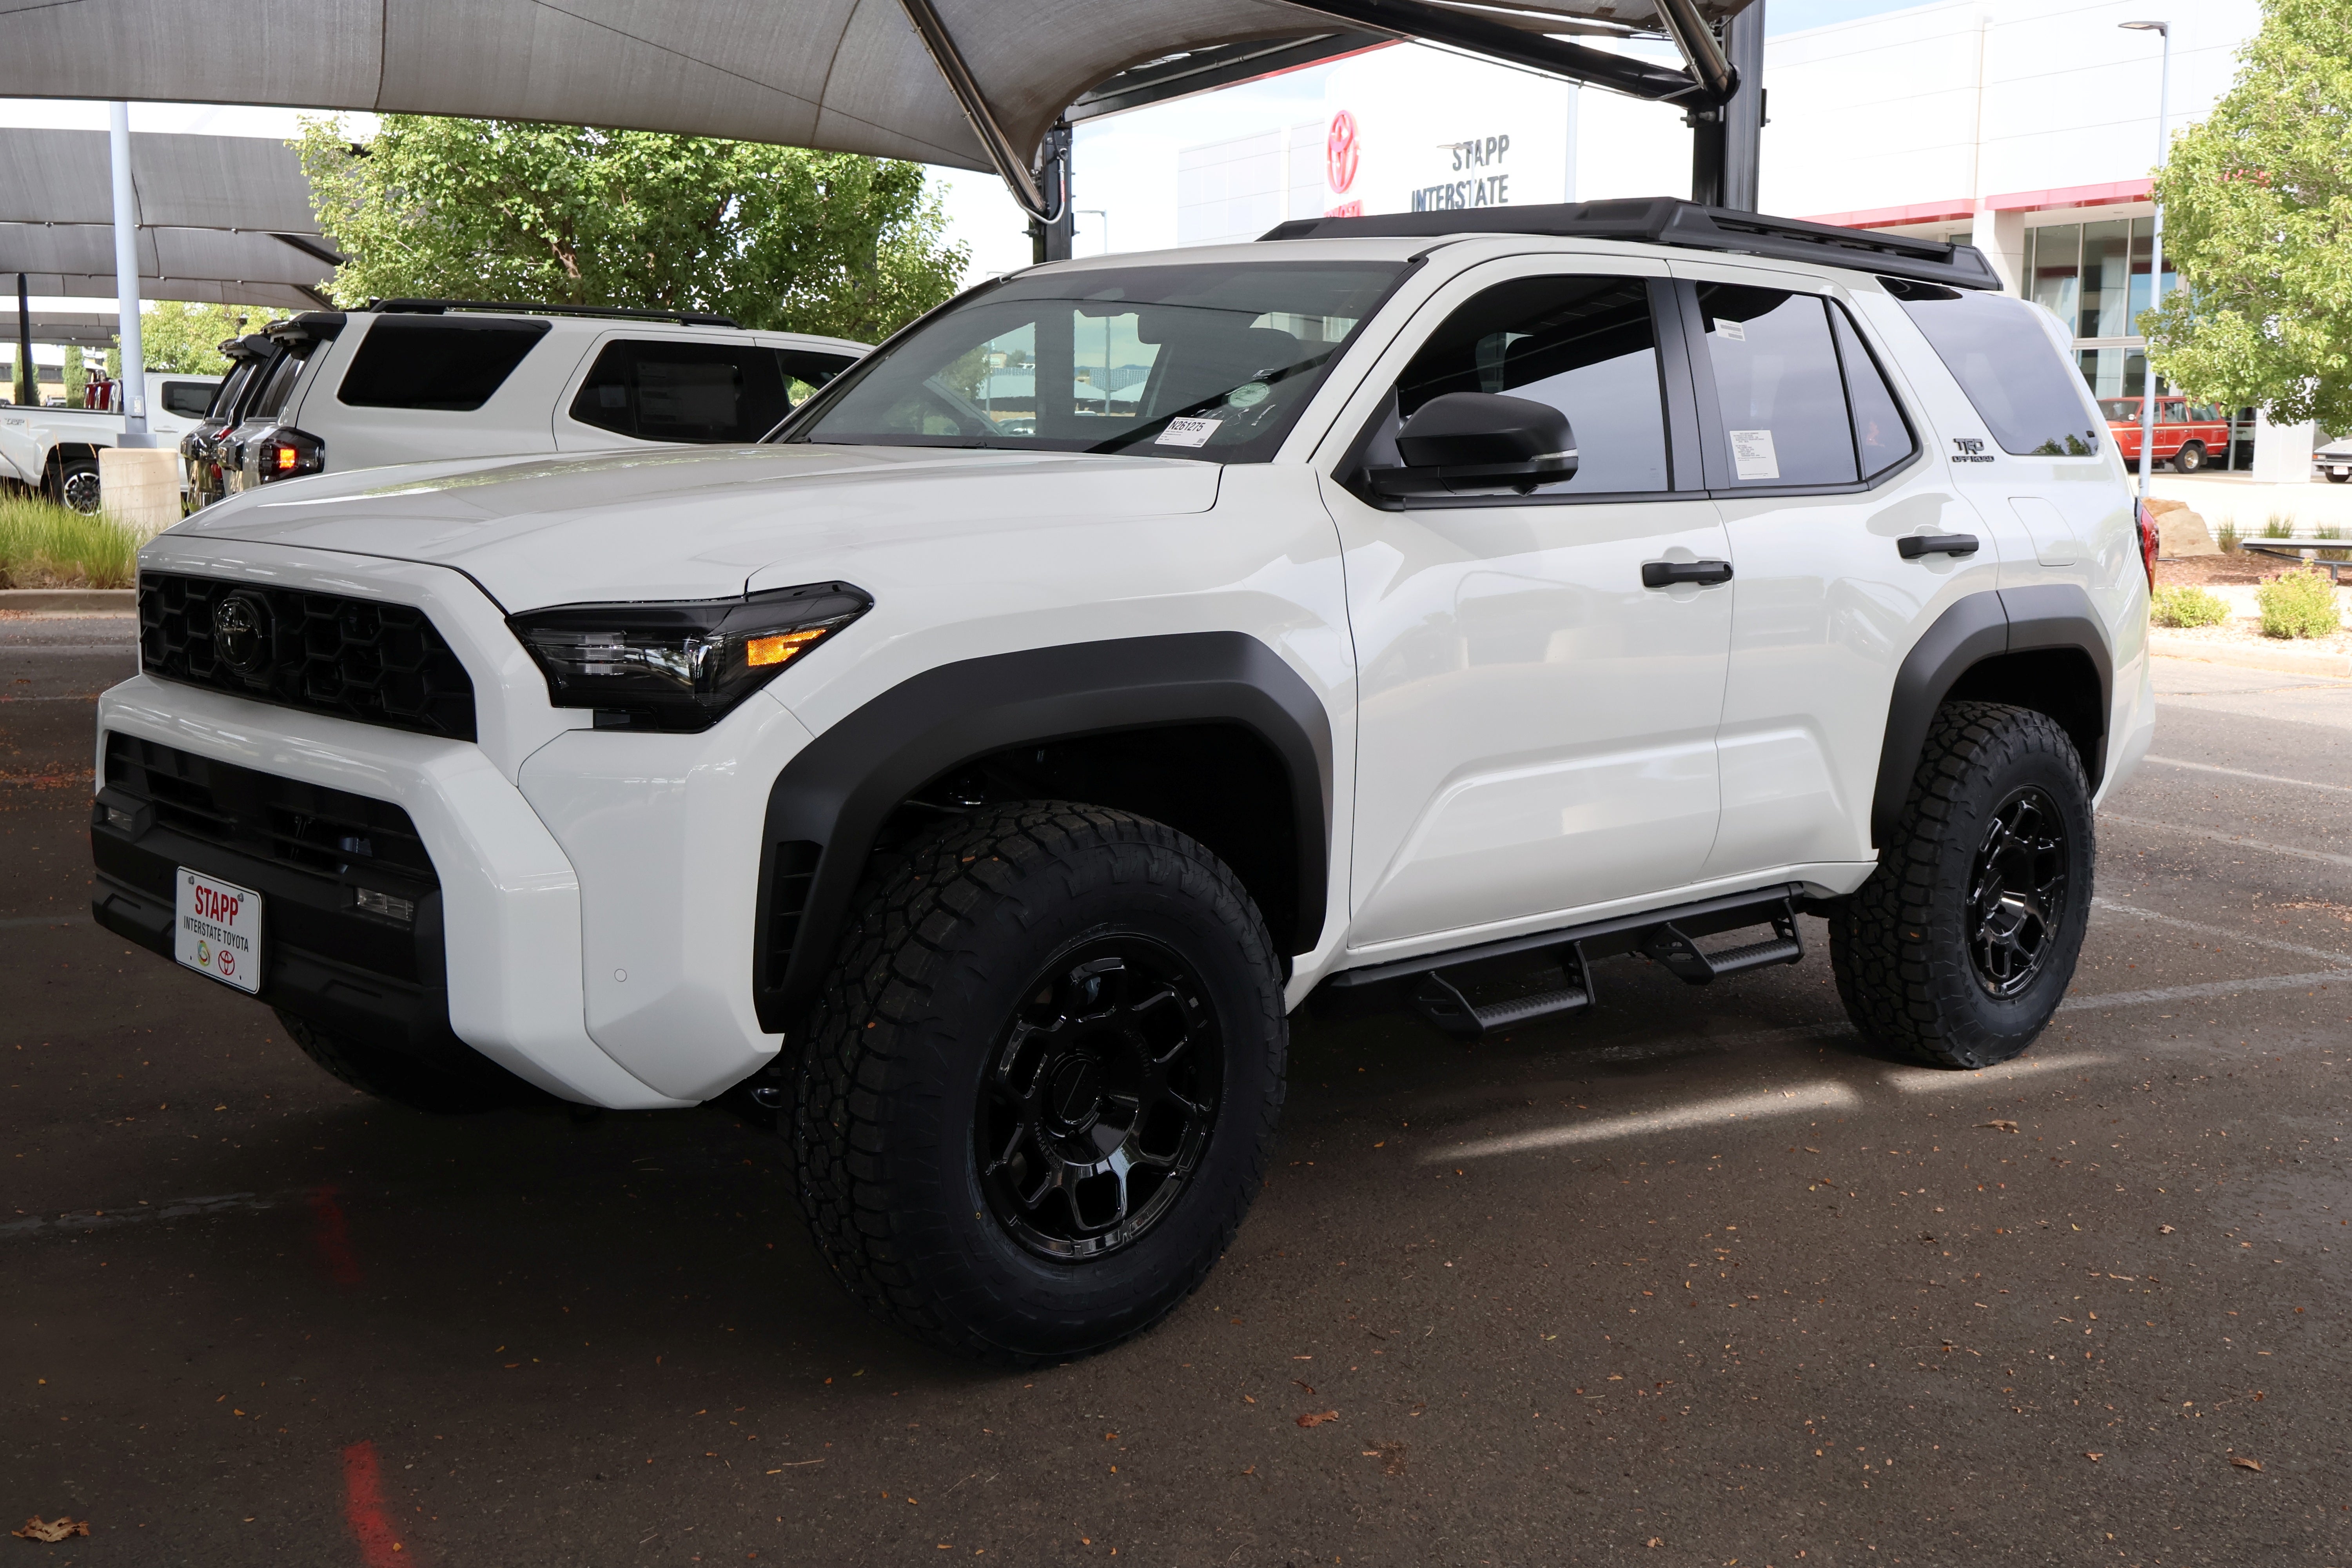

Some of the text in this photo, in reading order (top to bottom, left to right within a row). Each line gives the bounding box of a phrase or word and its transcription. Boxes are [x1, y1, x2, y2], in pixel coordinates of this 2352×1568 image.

[1452, 134, 1509, 171] STAPP
[1168, 421, 1206, 432] N261275
[1953, 438, 1984, 455] TRD
[195, 885, 238, 926] STAPP
[184, 916, 249, 953] INTERSTATE TOYOTA
